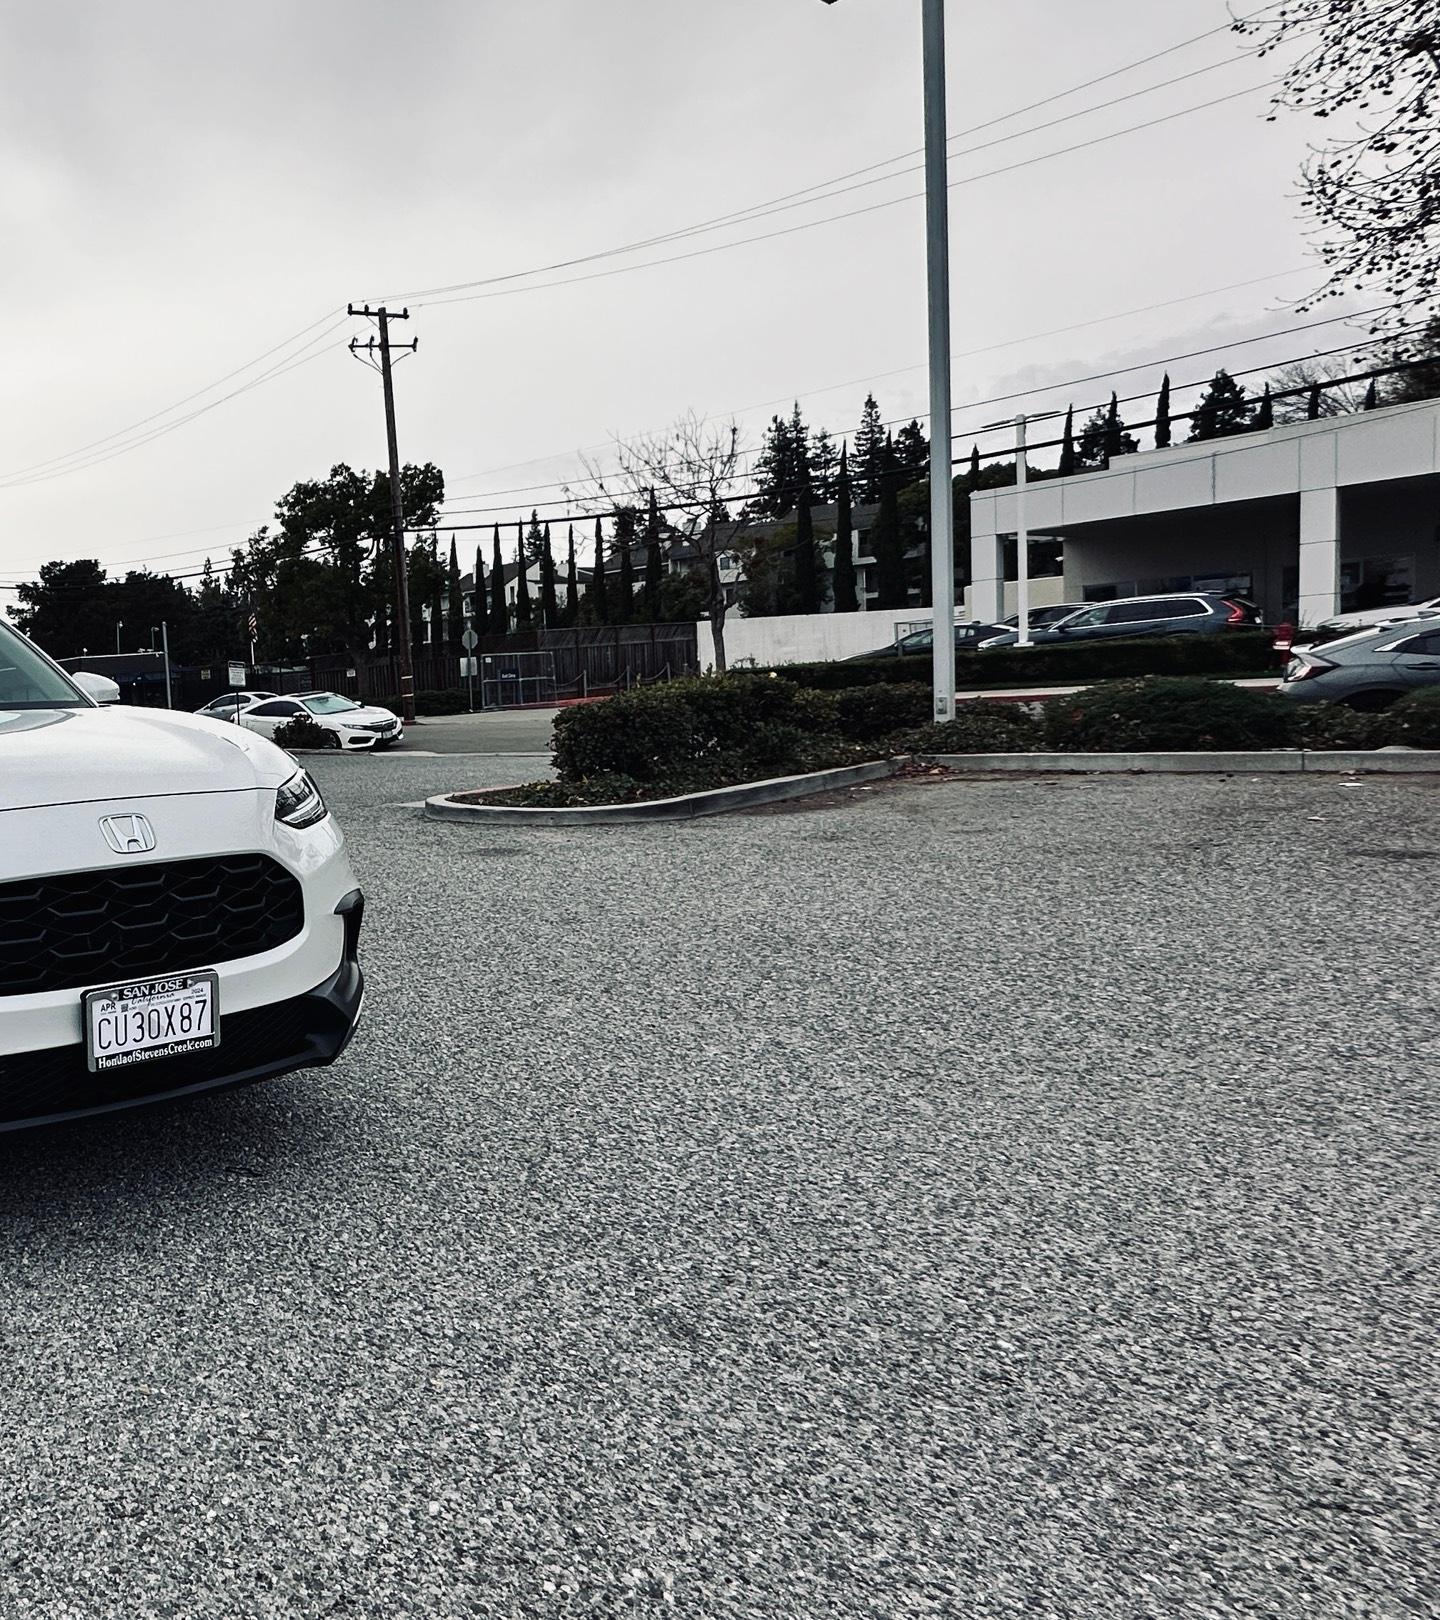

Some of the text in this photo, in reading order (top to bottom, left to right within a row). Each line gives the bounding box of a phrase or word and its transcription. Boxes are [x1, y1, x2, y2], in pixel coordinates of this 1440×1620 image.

[122, 979, 184, 999] SAN JOSE
[100, 1001, 117, 1013] APR
[98, 998, 207, 1050] CU30X87
[98, 1038, 213, 1069] HondaofStevensCreek.com
